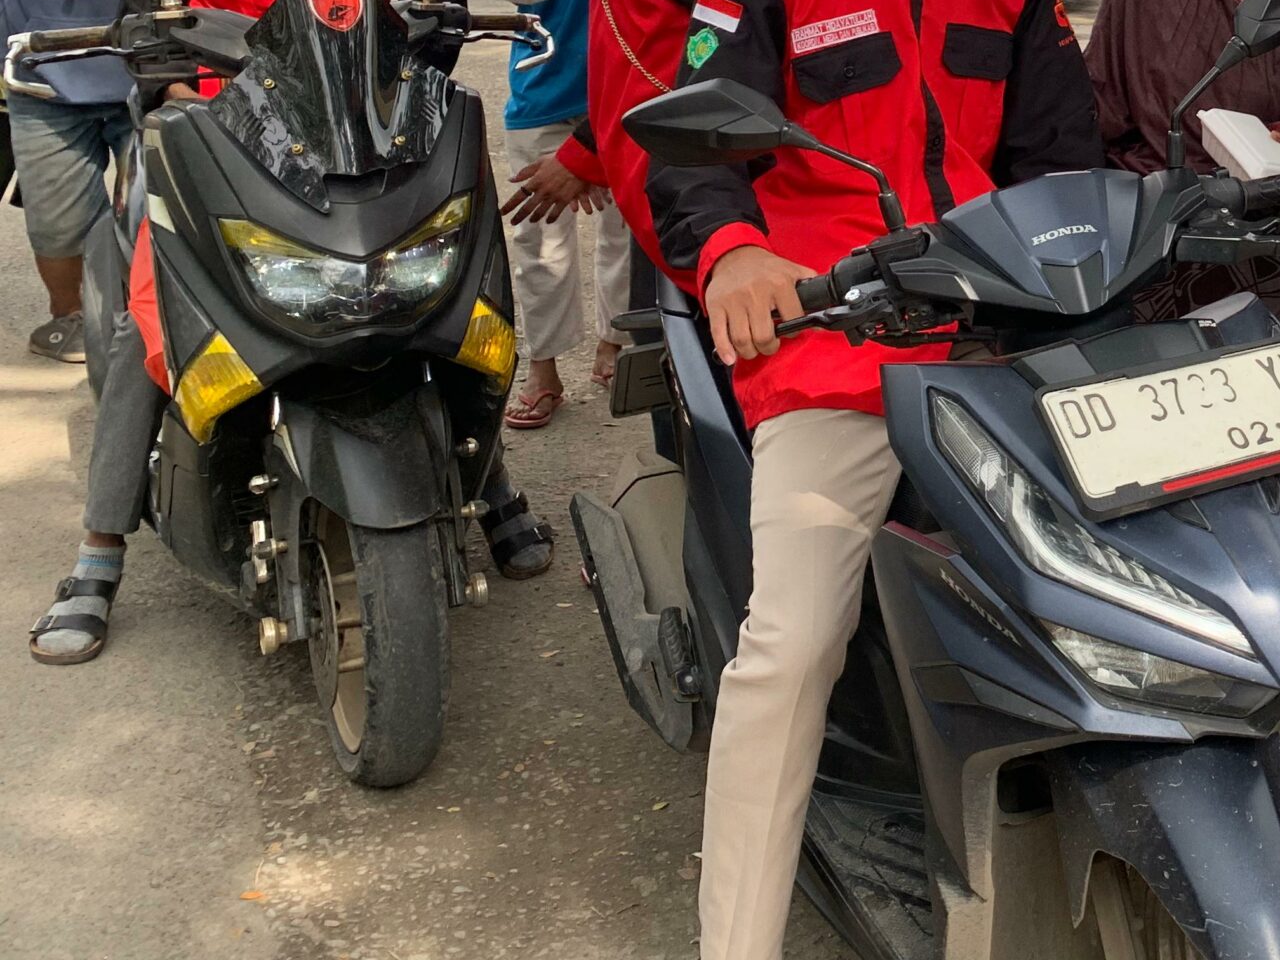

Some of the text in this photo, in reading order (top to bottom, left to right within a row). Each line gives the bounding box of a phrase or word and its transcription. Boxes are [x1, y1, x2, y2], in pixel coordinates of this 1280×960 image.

[1031, 224, 1098, 246] HONDA
[1059, 393, 1117, 439] DD
[939, 567, 1022, 648] HONDA
